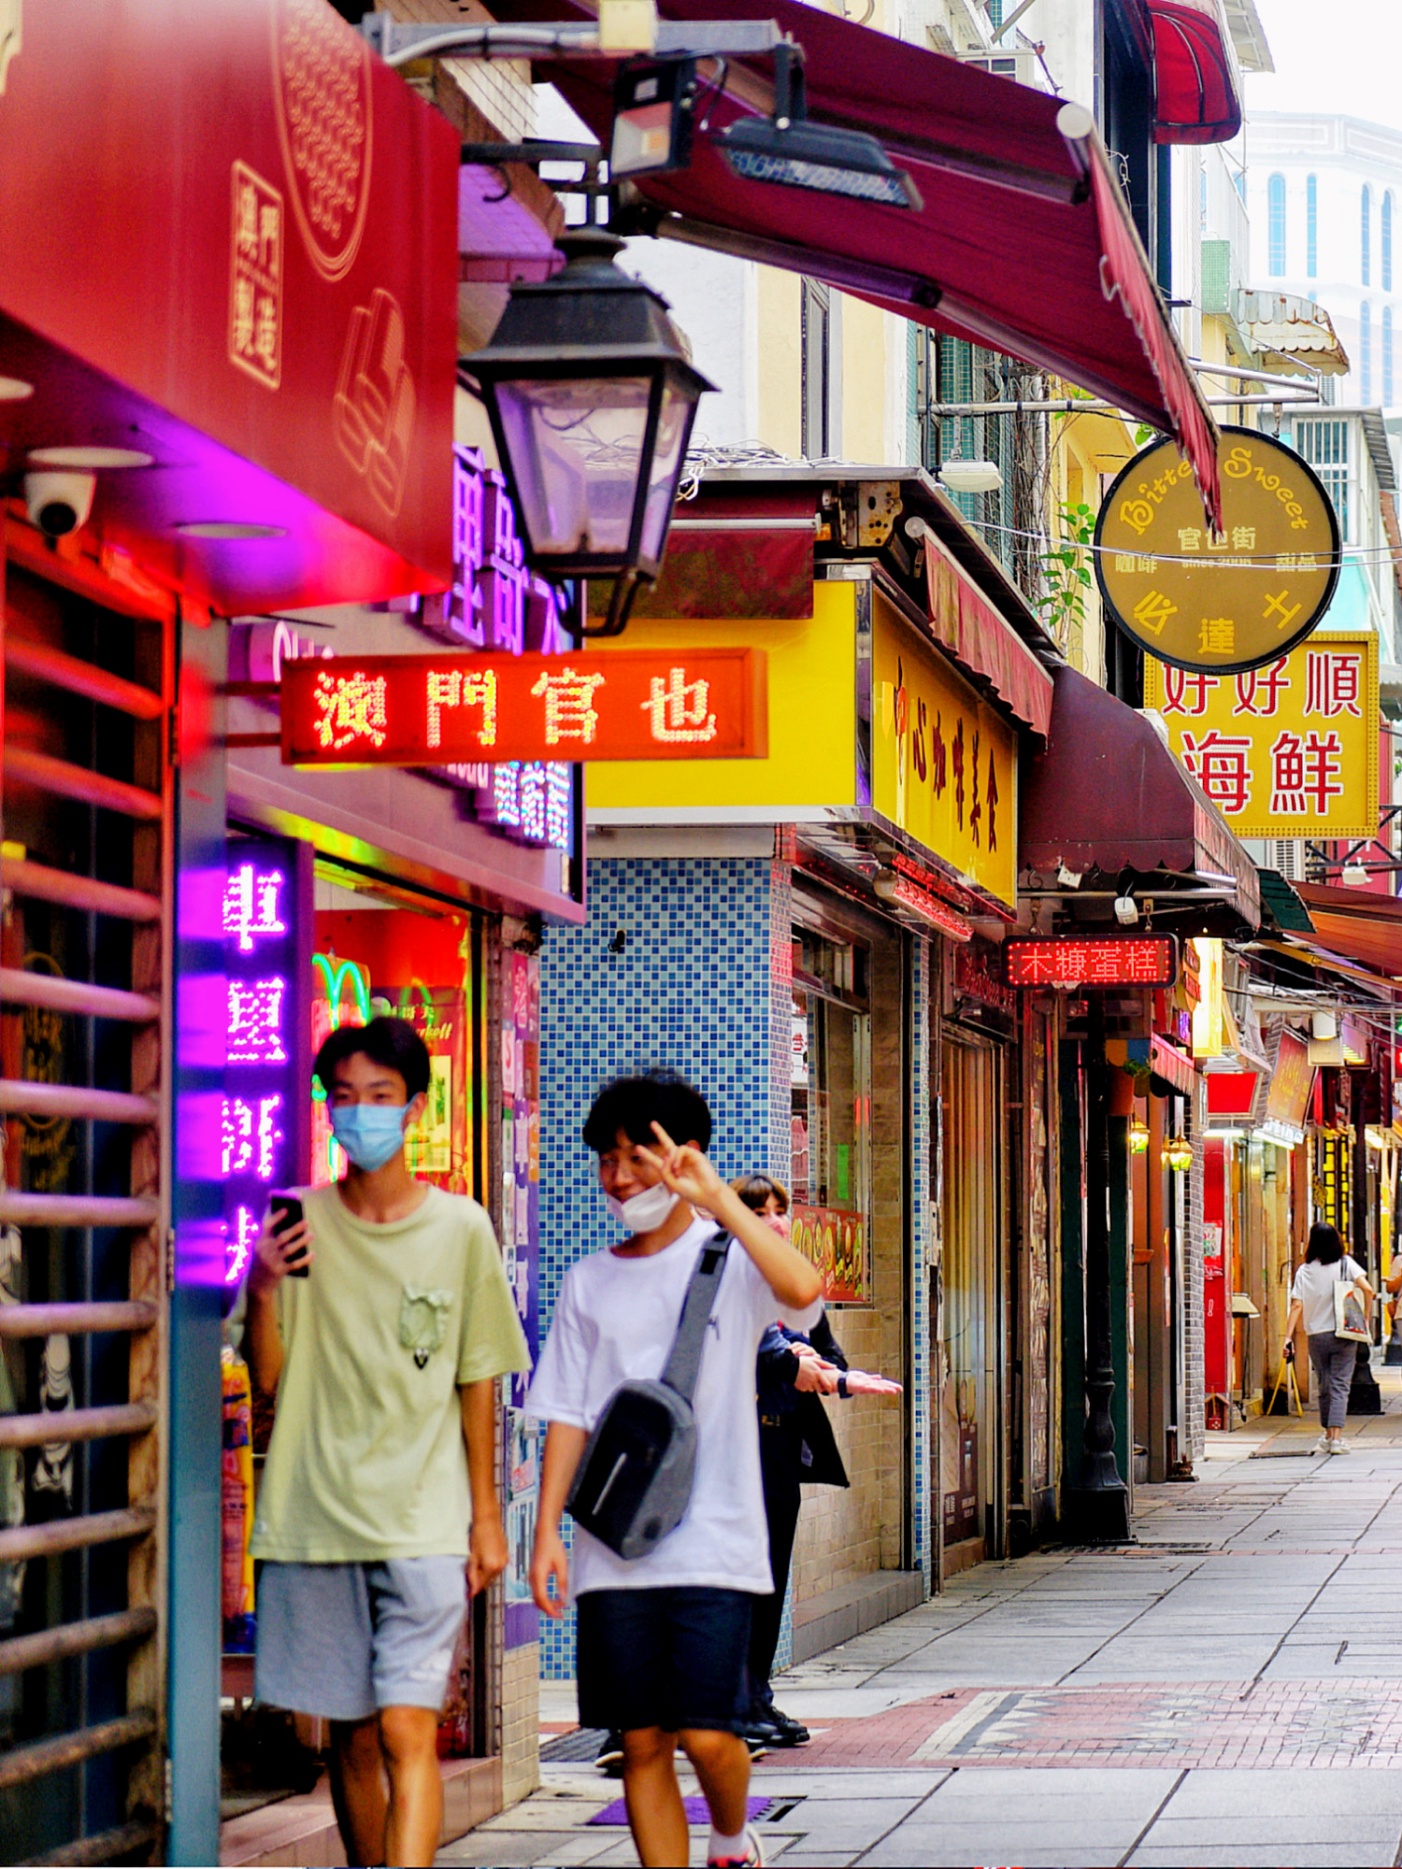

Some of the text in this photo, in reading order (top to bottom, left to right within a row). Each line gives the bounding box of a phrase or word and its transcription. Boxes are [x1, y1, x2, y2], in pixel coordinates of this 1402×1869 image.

[1119, 447, 1309, 536] Bitte Sweet
[313, 667, 718, 750] 澳門官也
[1162, 652, 1362, 717] 好好順
[1183, 730, 1342, 816] 海鮮
[1020, 945, 1158, 979] 木糠蛋糕
